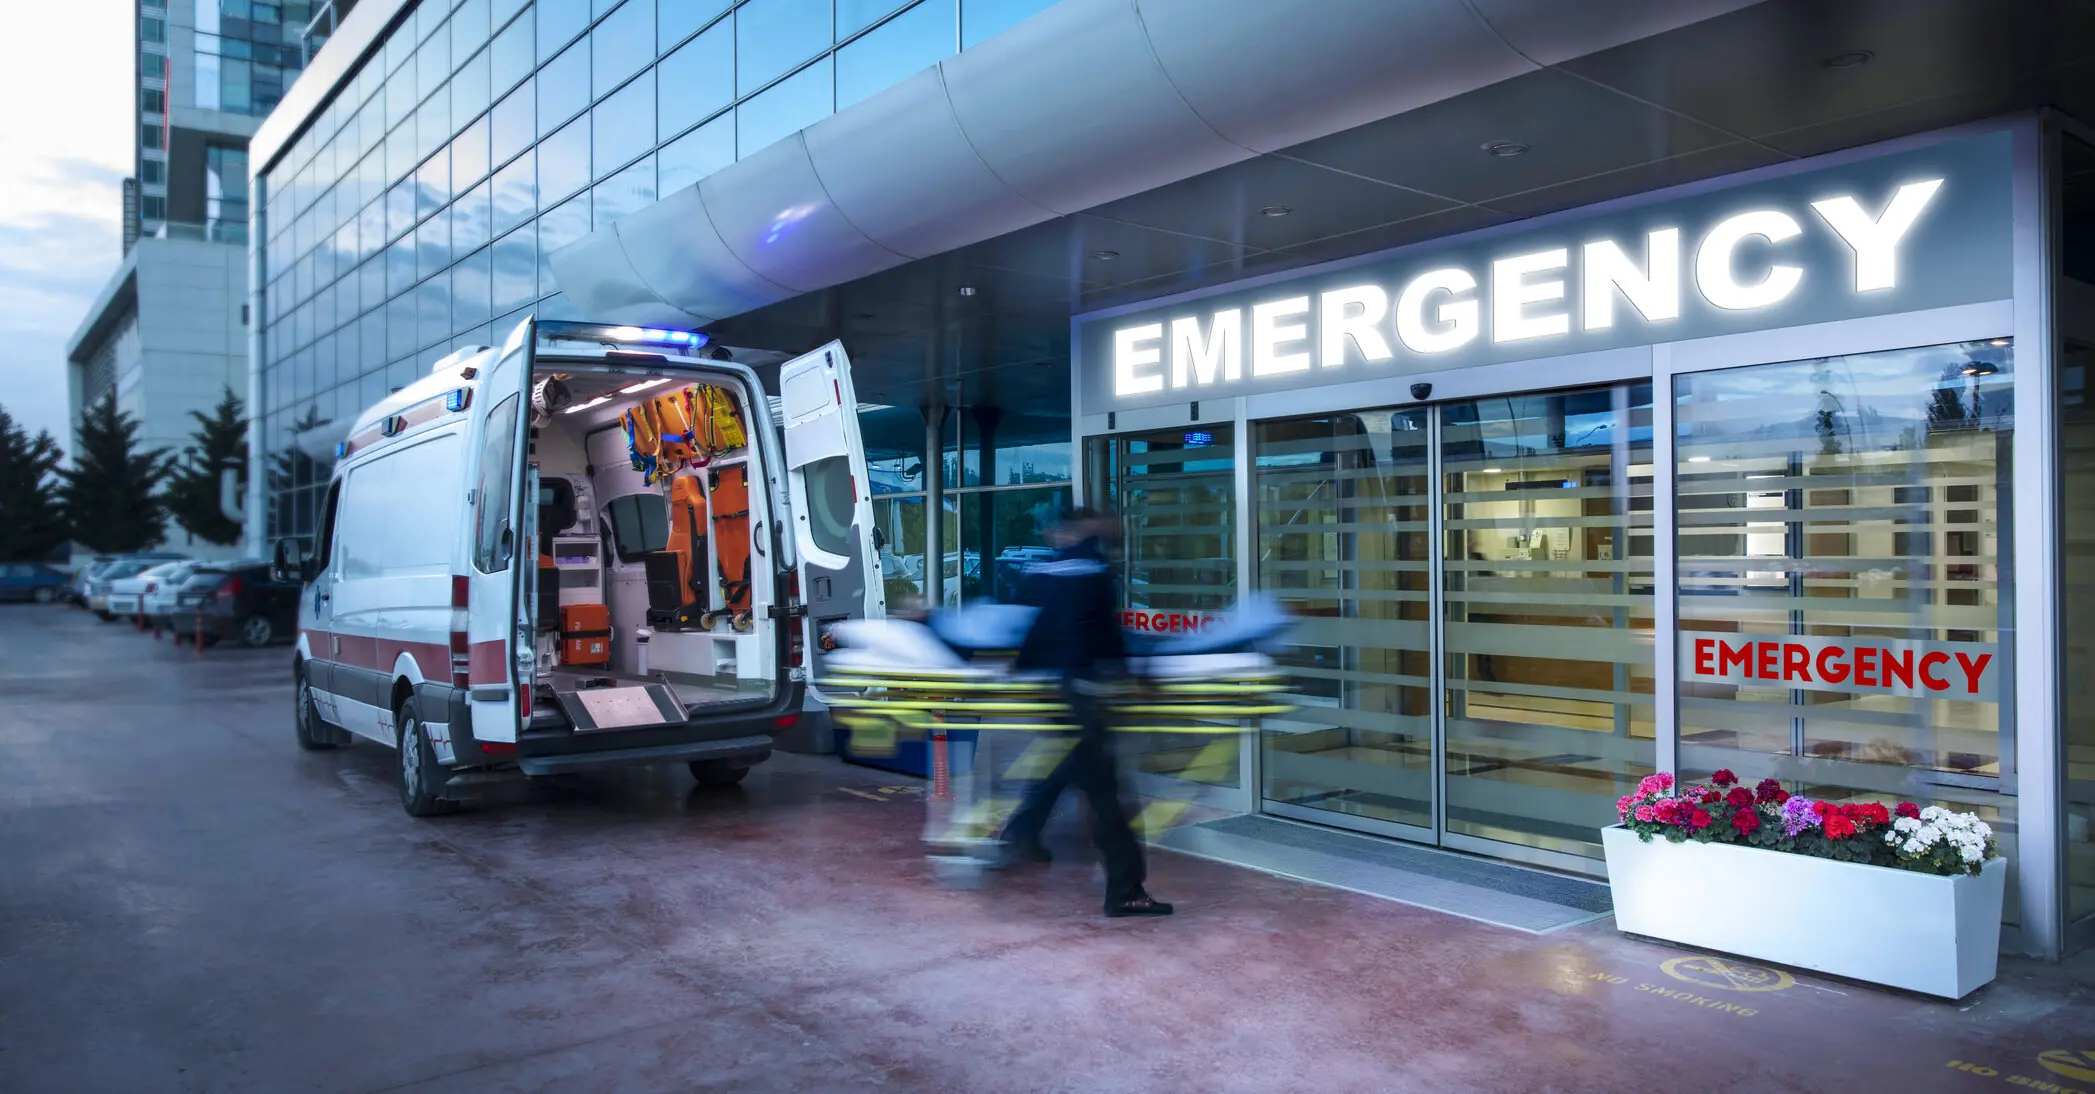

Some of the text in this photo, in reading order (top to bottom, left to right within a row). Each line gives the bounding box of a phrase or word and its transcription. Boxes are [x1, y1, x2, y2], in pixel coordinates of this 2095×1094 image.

[1115, 179, 1945, 396] EMERGENCY
[1695, 638, 1992, 693] EMERGENCY
[1589, 972, 1759, 1017] NO SMOKING
